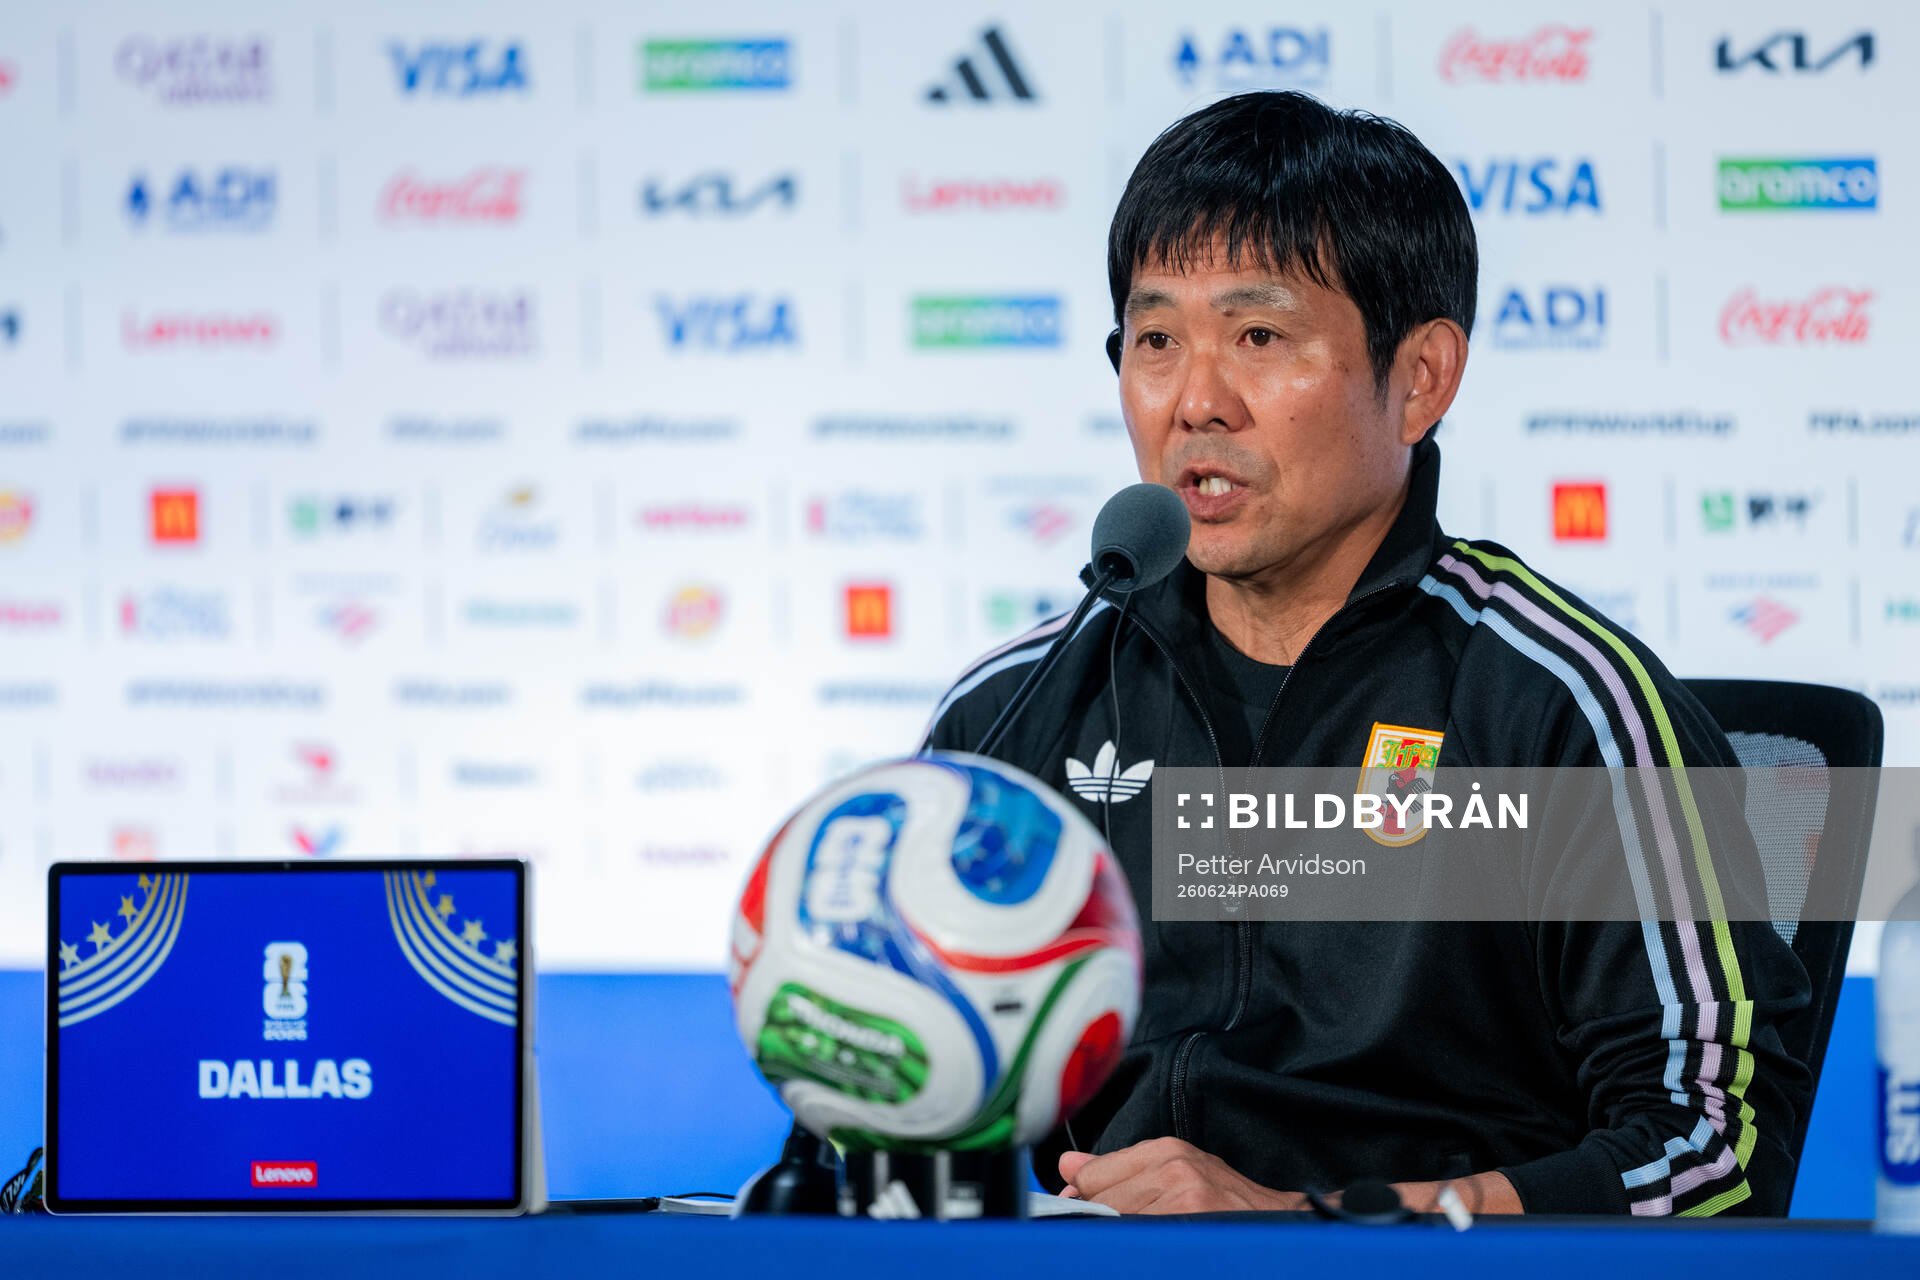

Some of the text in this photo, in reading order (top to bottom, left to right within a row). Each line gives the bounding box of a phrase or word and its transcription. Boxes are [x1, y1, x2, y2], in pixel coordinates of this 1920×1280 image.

[1219, 28, 1329, 67] ADI
[390, 43, 529, 94] VISA
[1458, 160, 1601, 213] VISA
[1721, 165, 1877, 203] aramco
[657, 296, 798, 349] VISA
[1496, 287, 1605, 328] ADI
[199, 1059, 373, 1099] DALLAS
[255, 1165, 313, 1182] Lenovo
